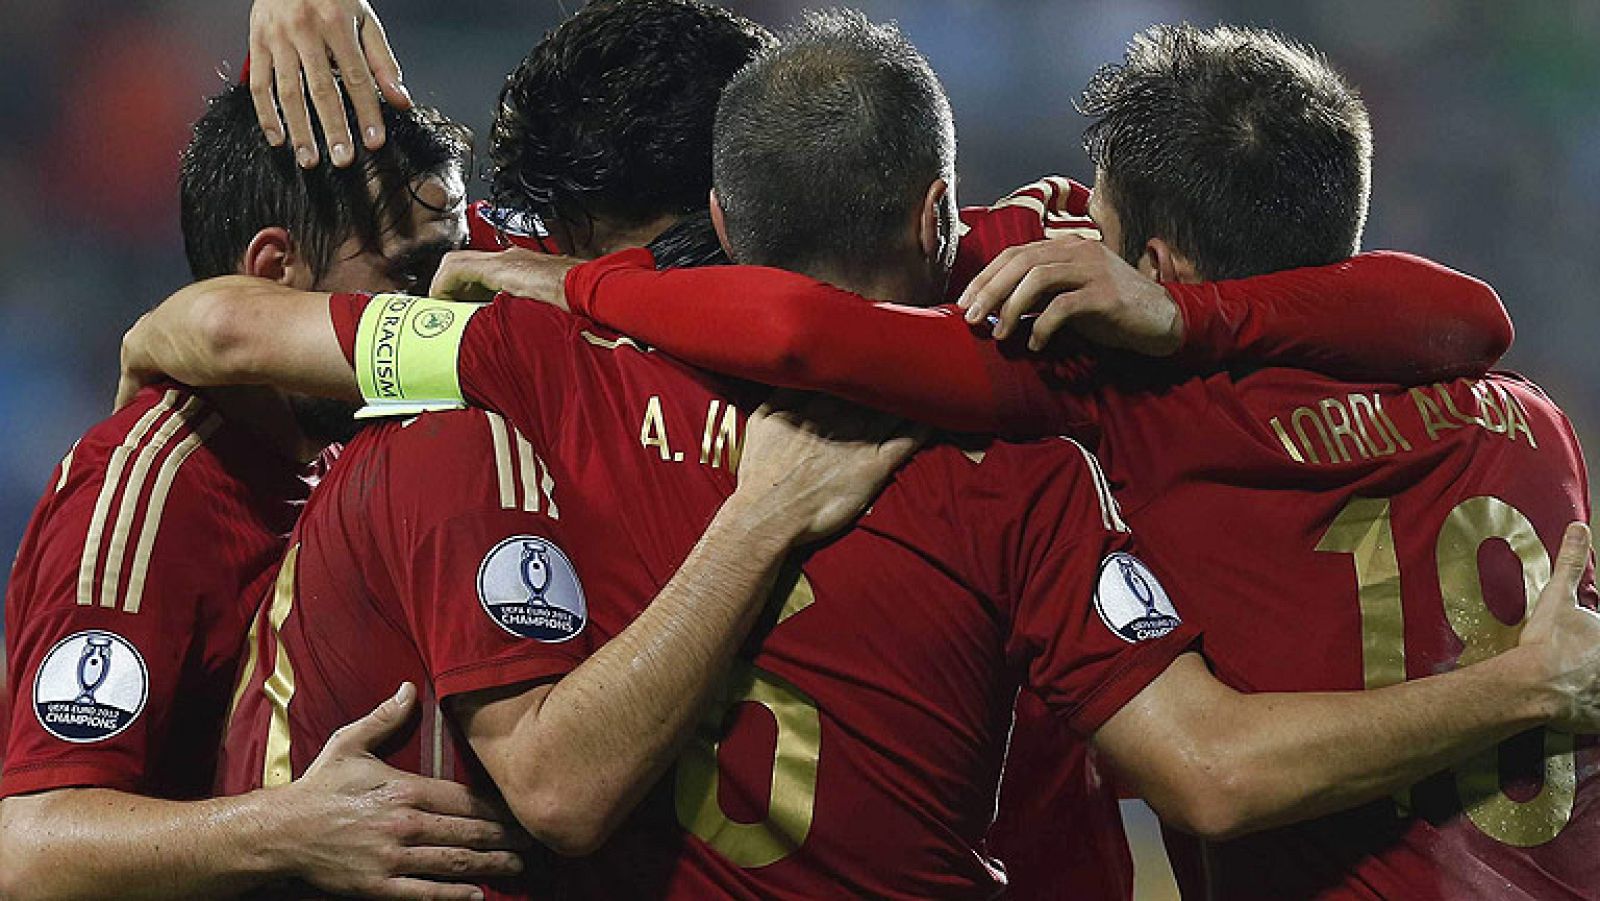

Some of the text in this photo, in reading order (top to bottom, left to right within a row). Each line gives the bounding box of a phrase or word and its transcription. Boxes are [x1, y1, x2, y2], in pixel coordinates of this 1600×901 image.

[377, 316, 400, 398] RACISM
[641, 395, 745, 475] A. IN
[501, 614, 573, 632] CHAMPIONS
[1315, 496, 1576, 848] 18
[46, 713, 117, 729] CHAMPIONS
